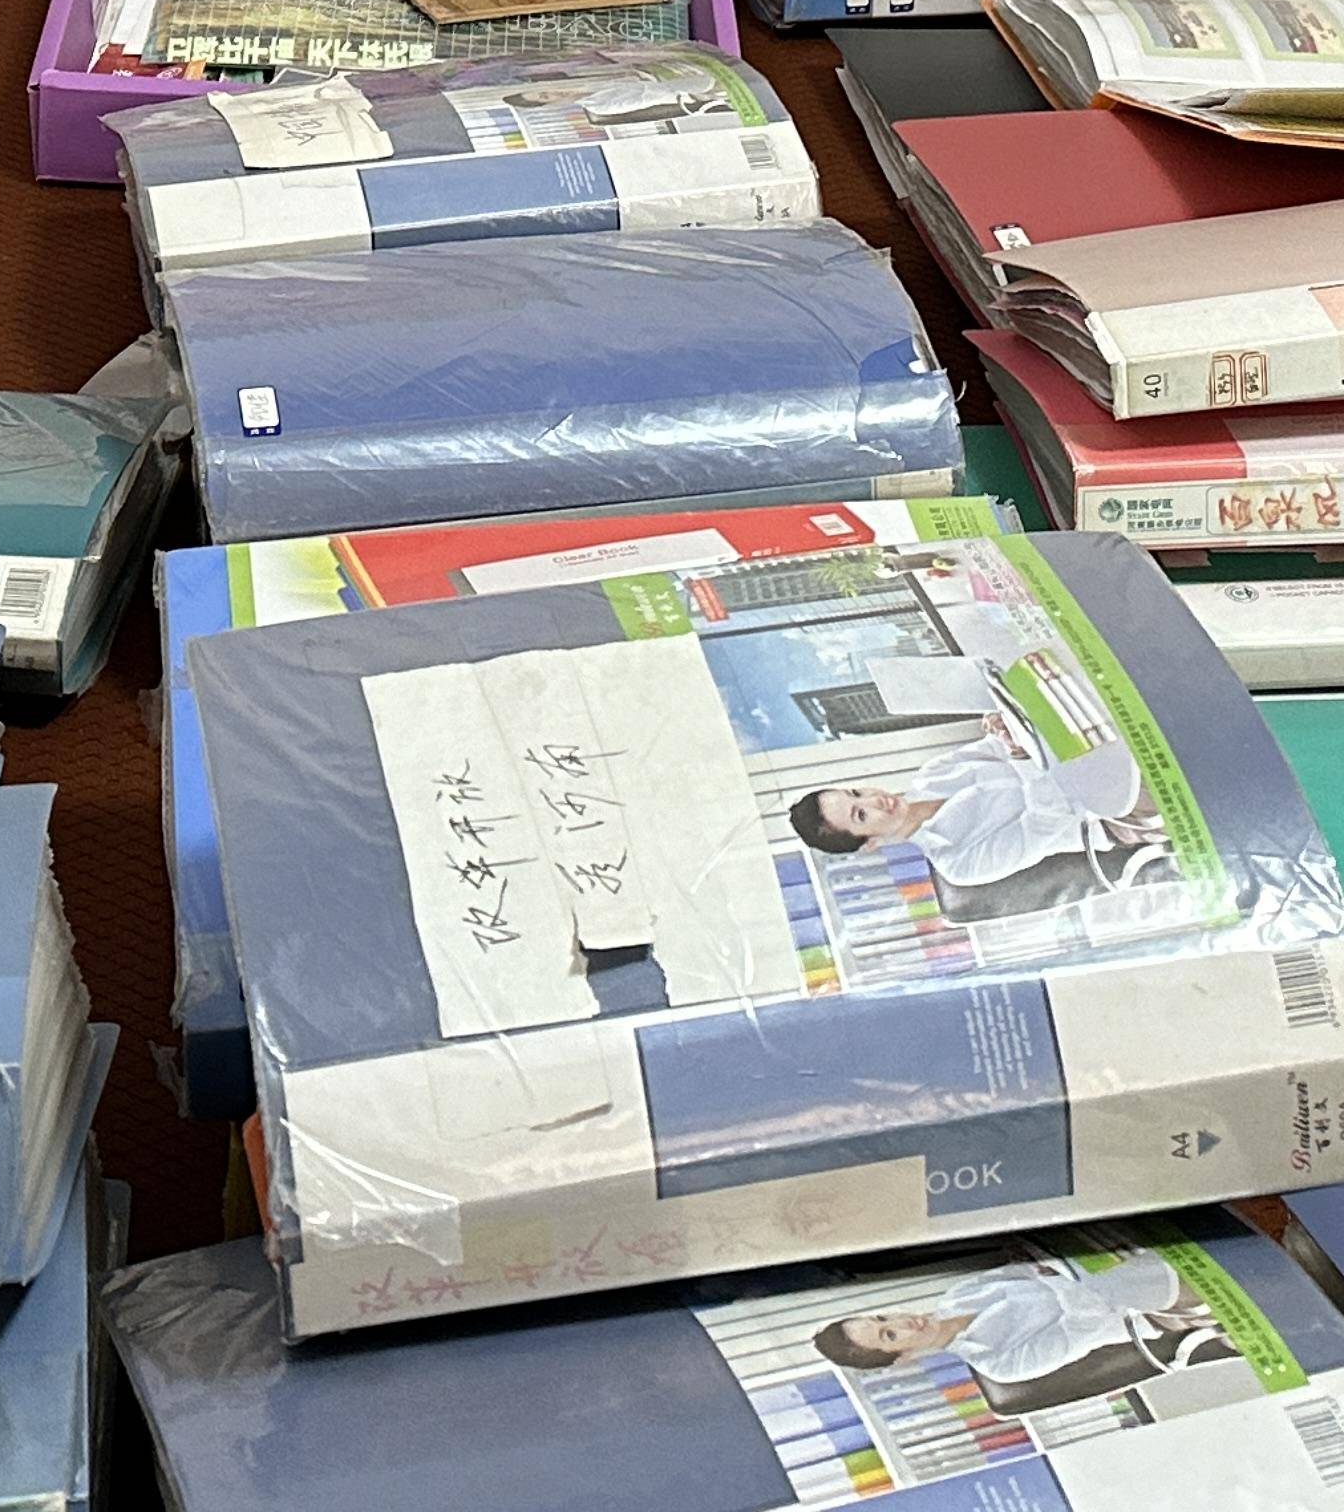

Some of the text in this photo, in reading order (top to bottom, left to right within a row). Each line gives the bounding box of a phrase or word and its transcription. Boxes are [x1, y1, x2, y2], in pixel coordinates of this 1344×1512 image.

[1143, 373, 1162, 399] 40
[1171, 1130, 1192, 1161] A4
[927, 1160, 1003, 1196] OOK
